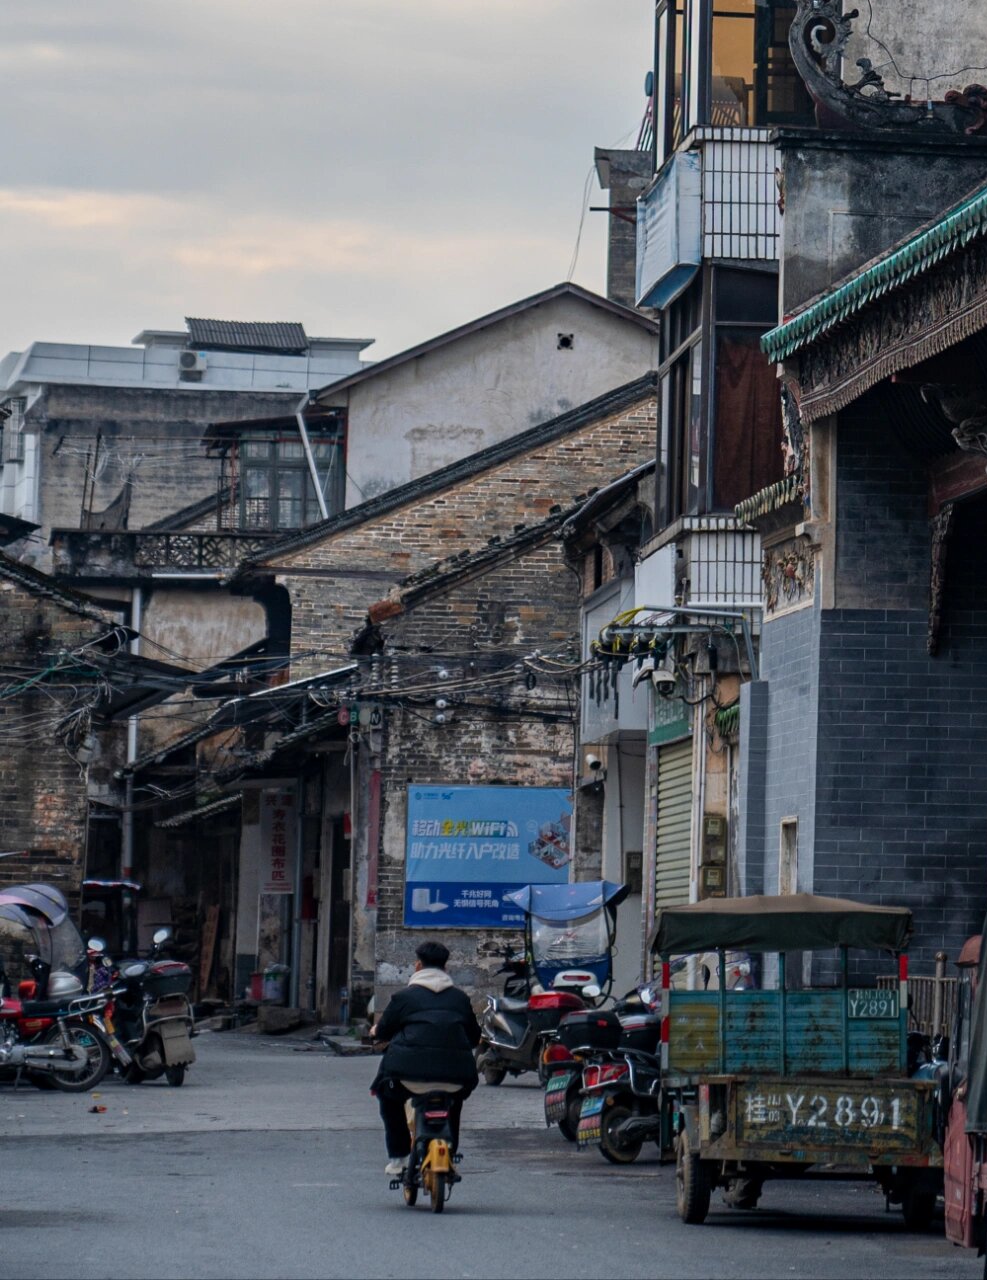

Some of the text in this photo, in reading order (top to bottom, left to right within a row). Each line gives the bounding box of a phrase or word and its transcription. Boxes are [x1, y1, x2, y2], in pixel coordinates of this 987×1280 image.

[350, 711, 357, 722] B
[371, 712, 379, 724] N
[410, 842, 520, 860] 助力光纤入户改造
[850, 999, 895, 1017] Y2891
[744, 1093, 767, 1124] 桂
[786, 1093, 901, 1130] Y2891
